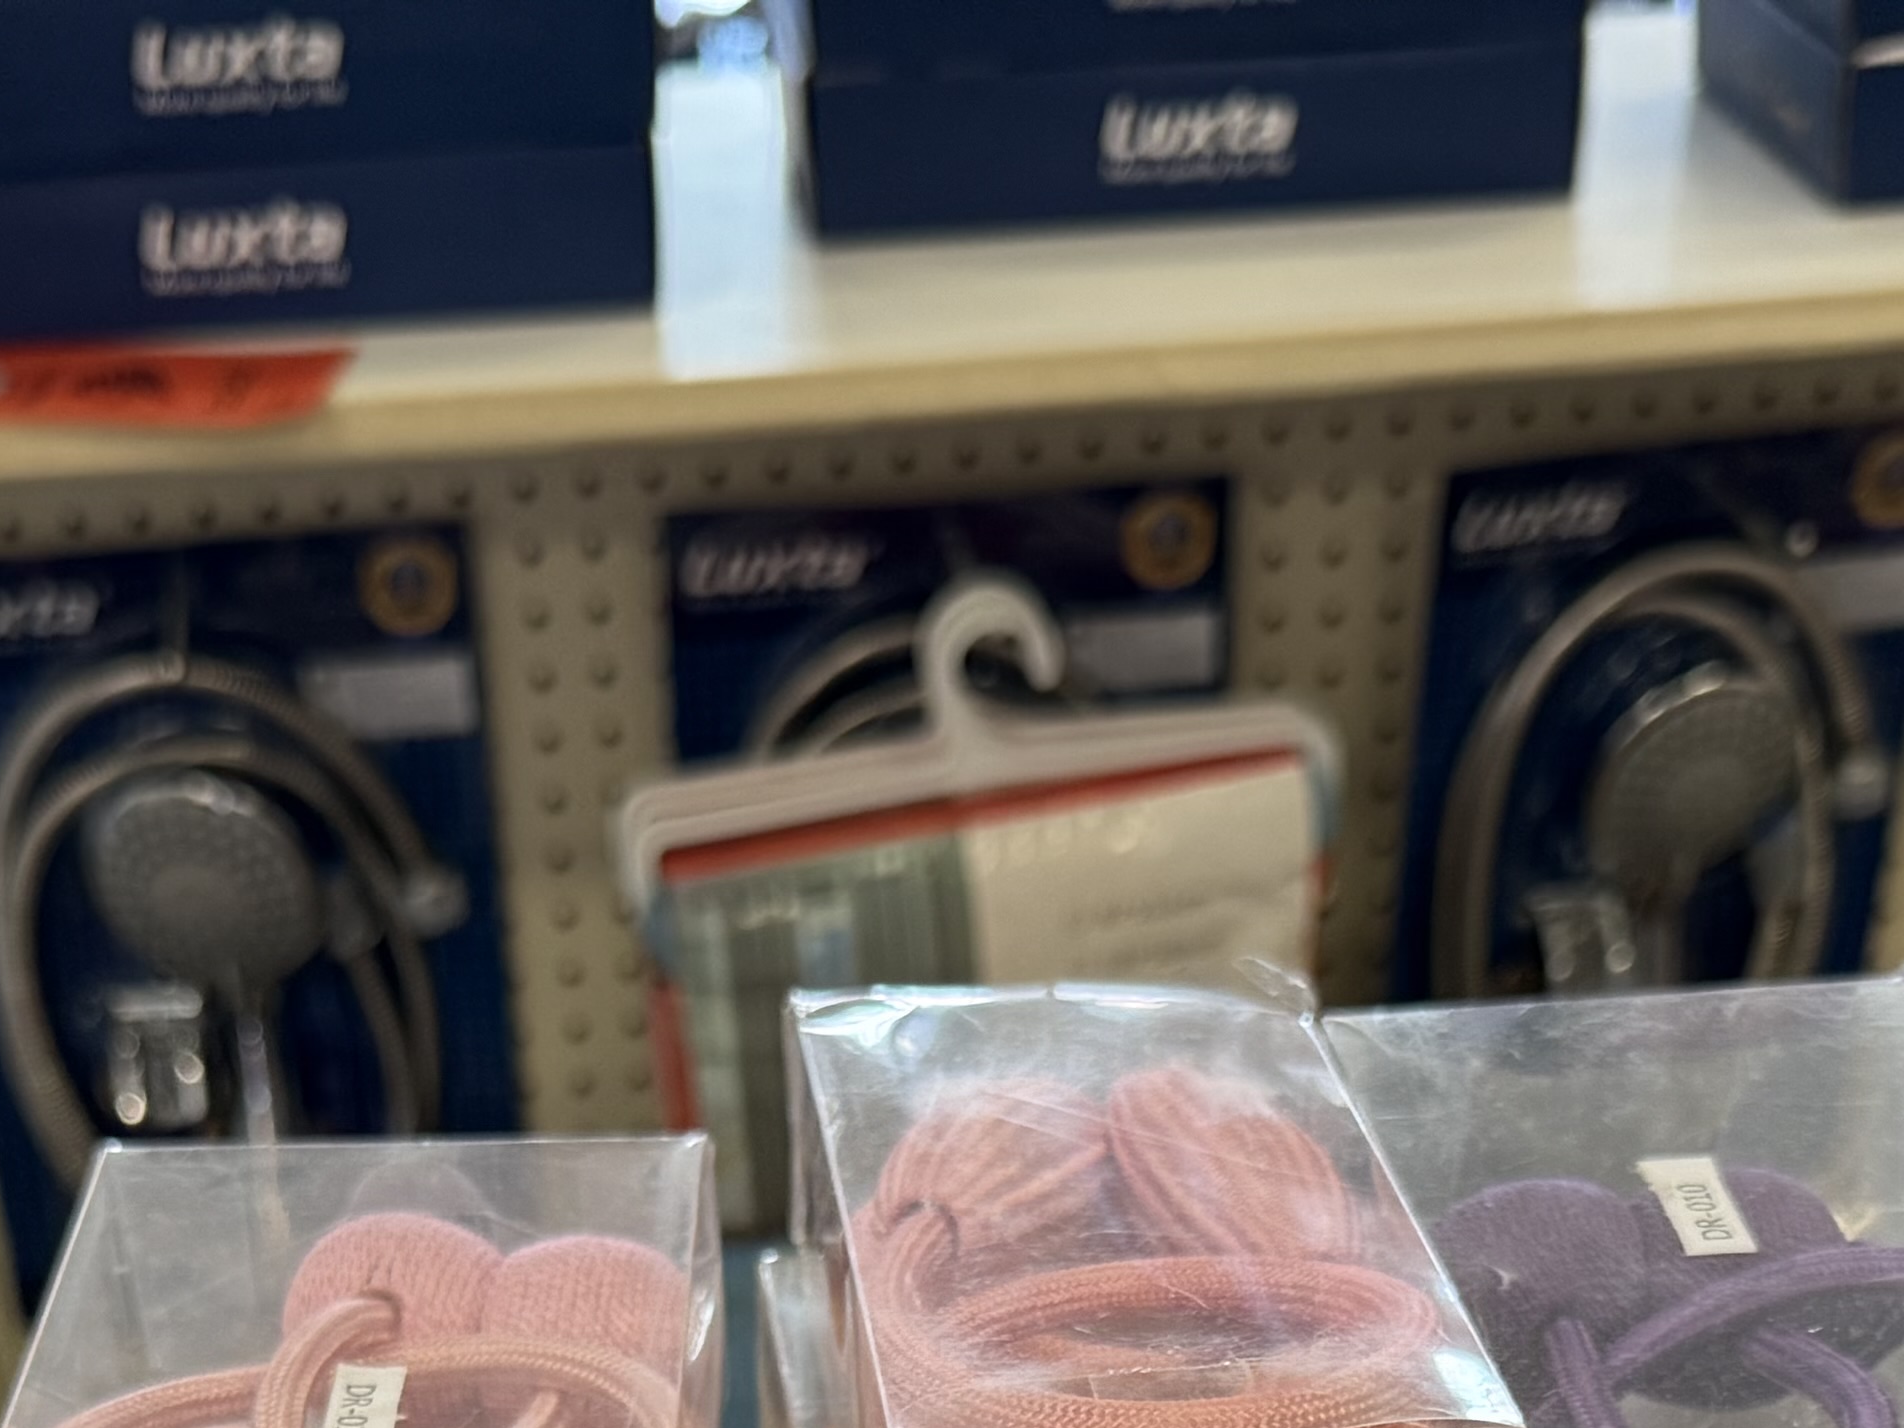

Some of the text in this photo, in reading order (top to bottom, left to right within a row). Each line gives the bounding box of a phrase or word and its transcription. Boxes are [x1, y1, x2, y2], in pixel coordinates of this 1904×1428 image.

[132, 14, 345, 89] Luxta
[1101, 89, 1297, 161] Luxta
[139, 198, 347, 271] Luxta
[1677, 1184, 1733, 1240] DR-010
